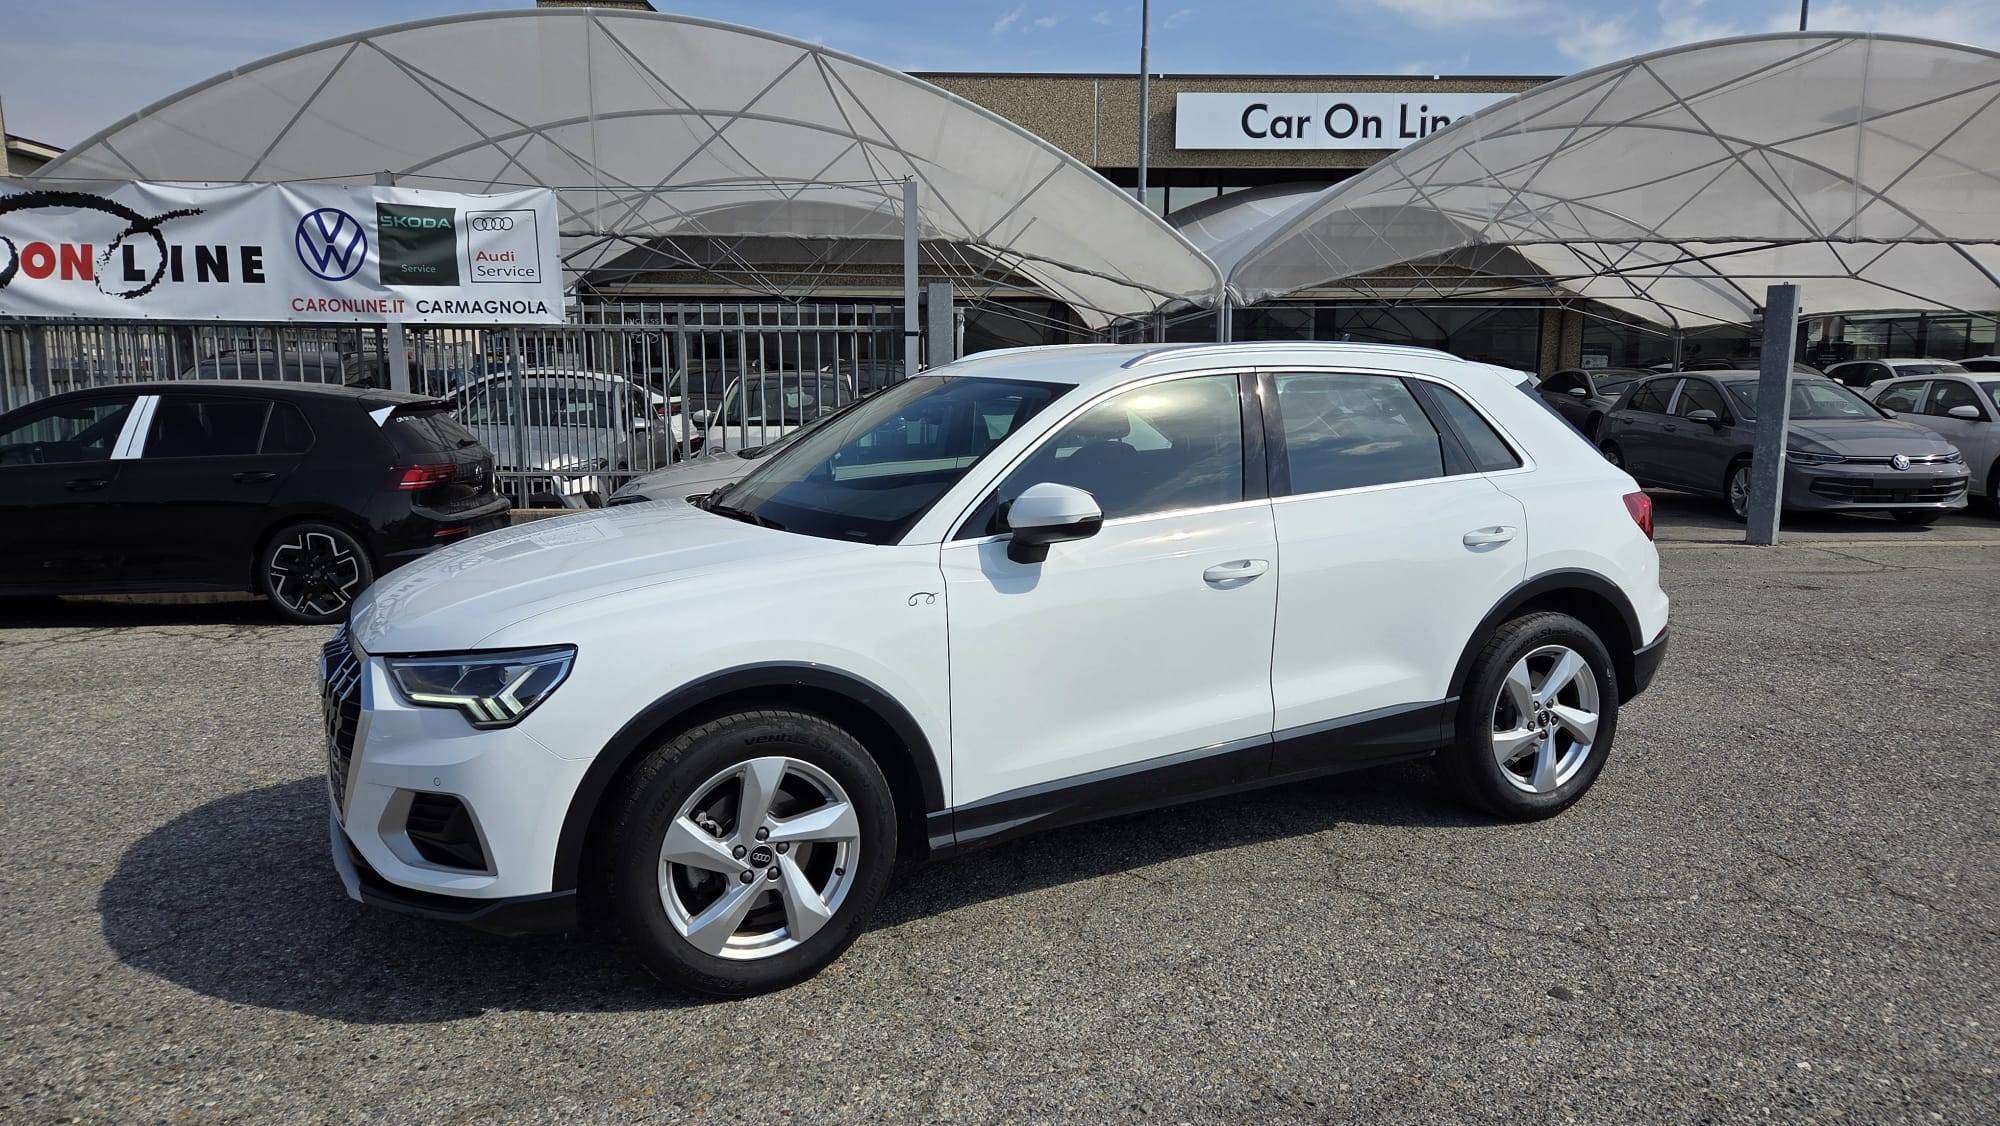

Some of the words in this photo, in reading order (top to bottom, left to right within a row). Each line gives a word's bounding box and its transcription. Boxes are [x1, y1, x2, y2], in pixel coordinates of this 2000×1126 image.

[1241, 103, 1311, 138] Car
[1324, 103, 1383, 138] On
[1399, 103, 1465, 138] Lin
[20, 242, 95, 281] ON
[122, 244, 266, 283] LINE
[475, 250, 516, 262] Audi
[401, 263, 437, 273] Service
[477, 265, 535, 277] Service
[292, 297, 405, 313] CARONLINE.IT
[416, 299, 548, 314] CARMAGNOLA
